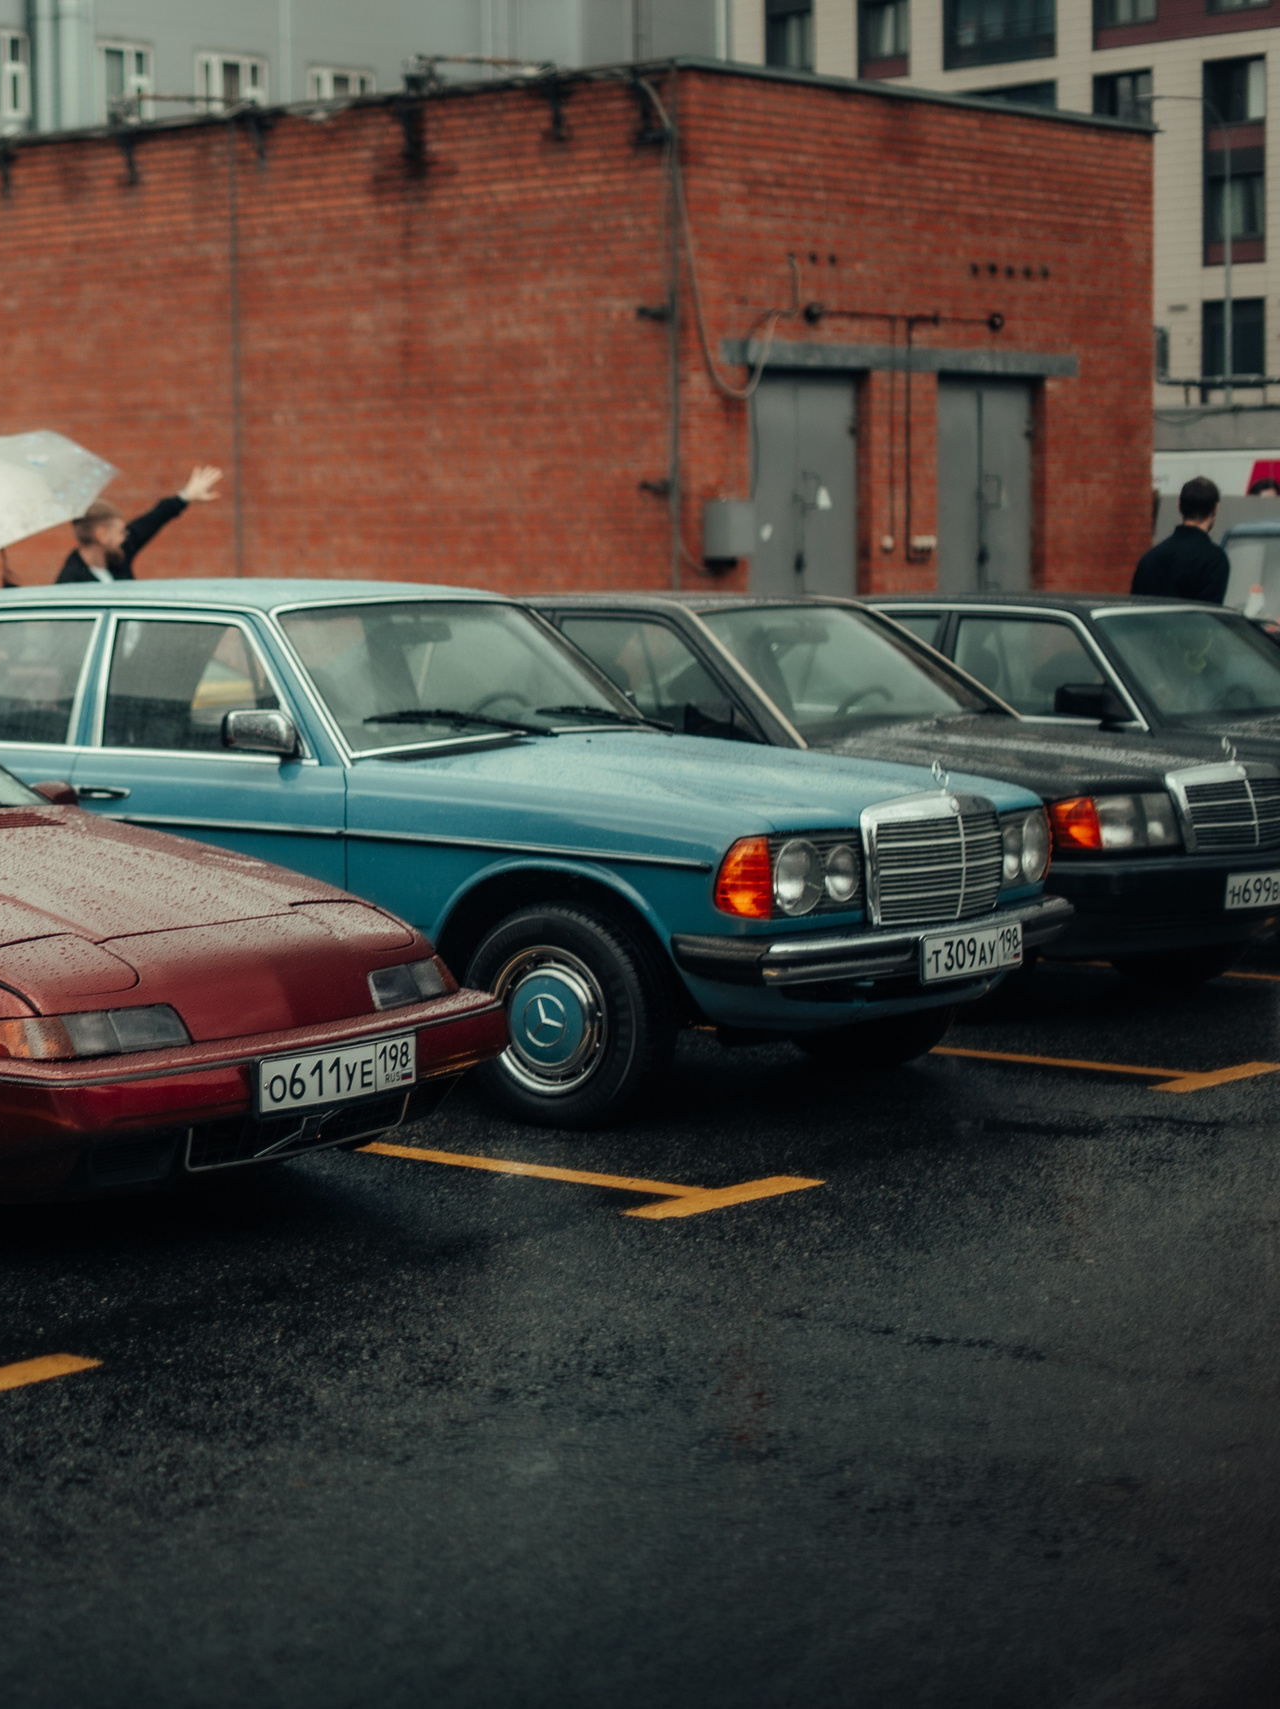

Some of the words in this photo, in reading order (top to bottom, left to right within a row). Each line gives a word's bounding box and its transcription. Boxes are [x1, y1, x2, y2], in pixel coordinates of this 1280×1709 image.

[999, 927, 1020, 952] 198
[269, 1057, 373, 1102] О611УЕ
[378, 1041, 410, 1073] 198
[385, 1071, 401, 1084] RUS
